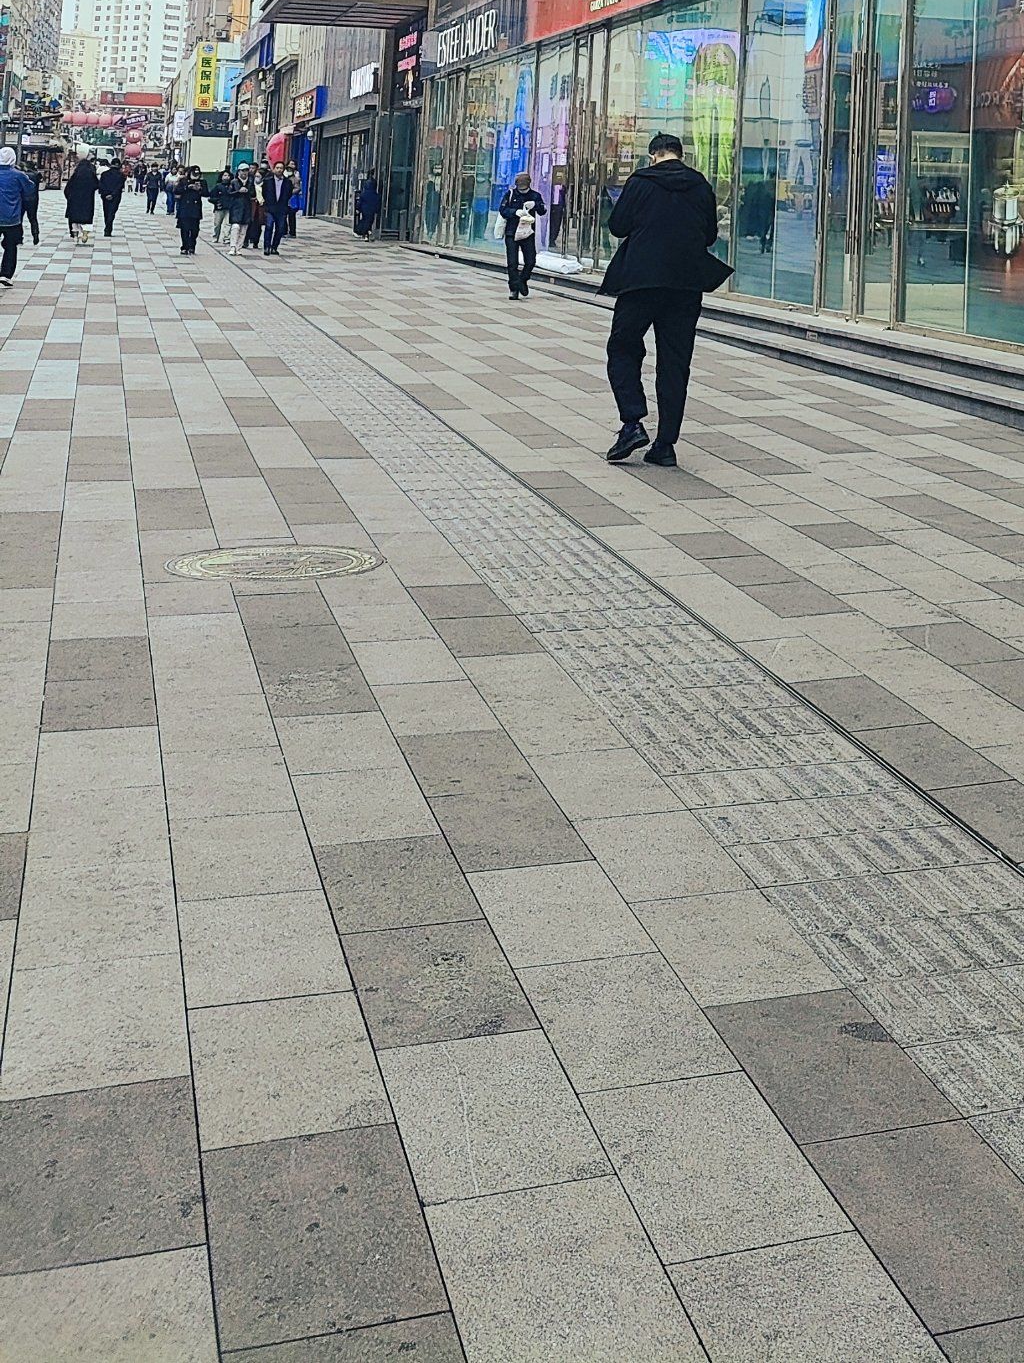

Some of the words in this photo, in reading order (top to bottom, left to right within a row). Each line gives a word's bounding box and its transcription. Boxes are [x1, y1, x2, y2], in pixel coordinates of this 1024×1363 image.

[460, 9, 497, 59] LAUDER
[199, 56, 213, 95] 医保城
